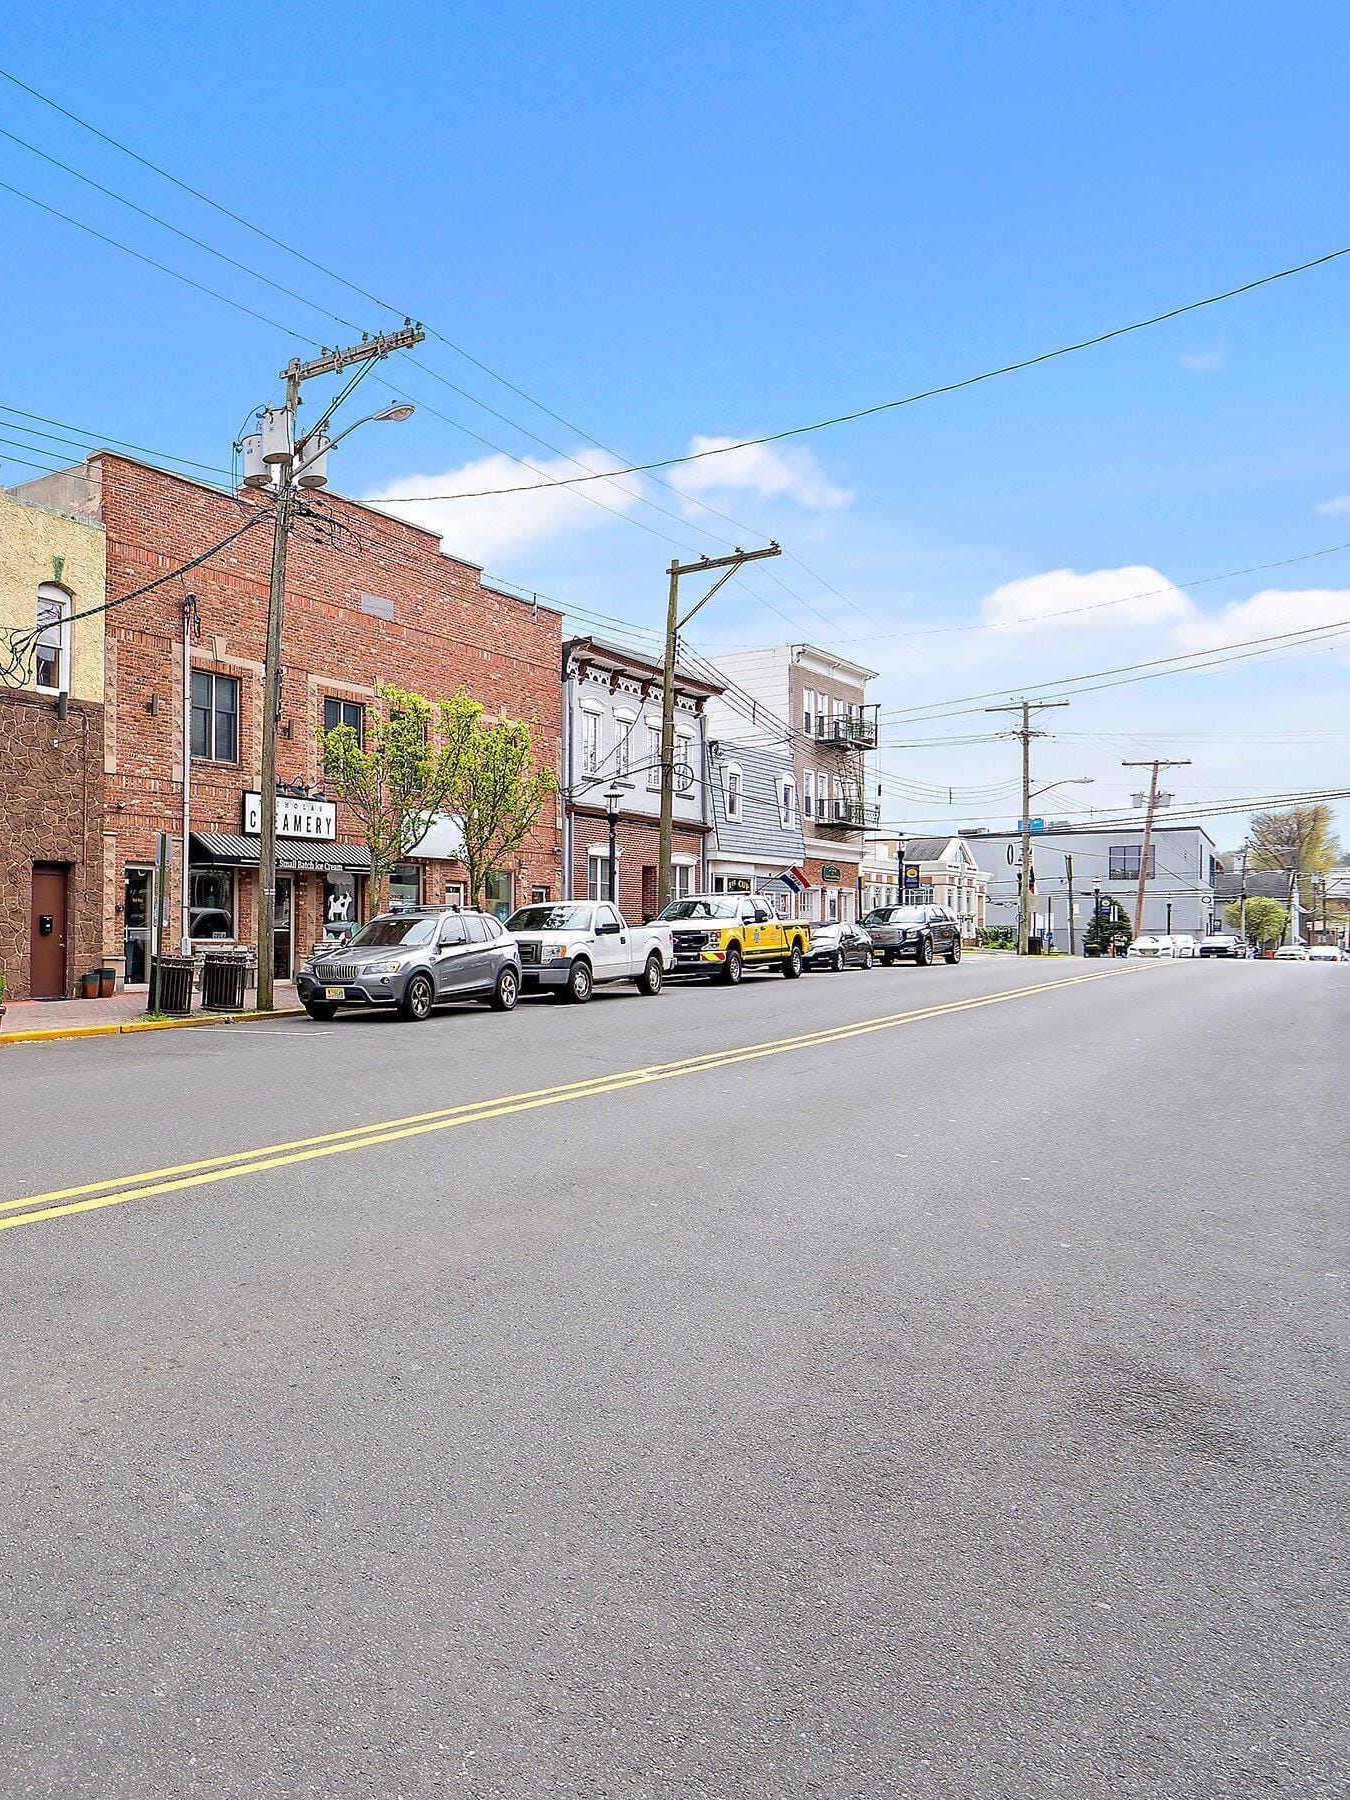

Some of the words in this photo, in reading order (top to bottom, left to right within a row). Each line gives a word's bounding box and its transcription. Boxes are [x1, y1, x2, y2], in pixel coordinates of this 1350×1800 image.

[250, 810, 332, 835] CEAMERY
[279, 860, 297, 868] Small
[298, 861, 314, 869] Batch
[315, 862, 324, 870] Ice
[324, 862, 343, 871] Cream
